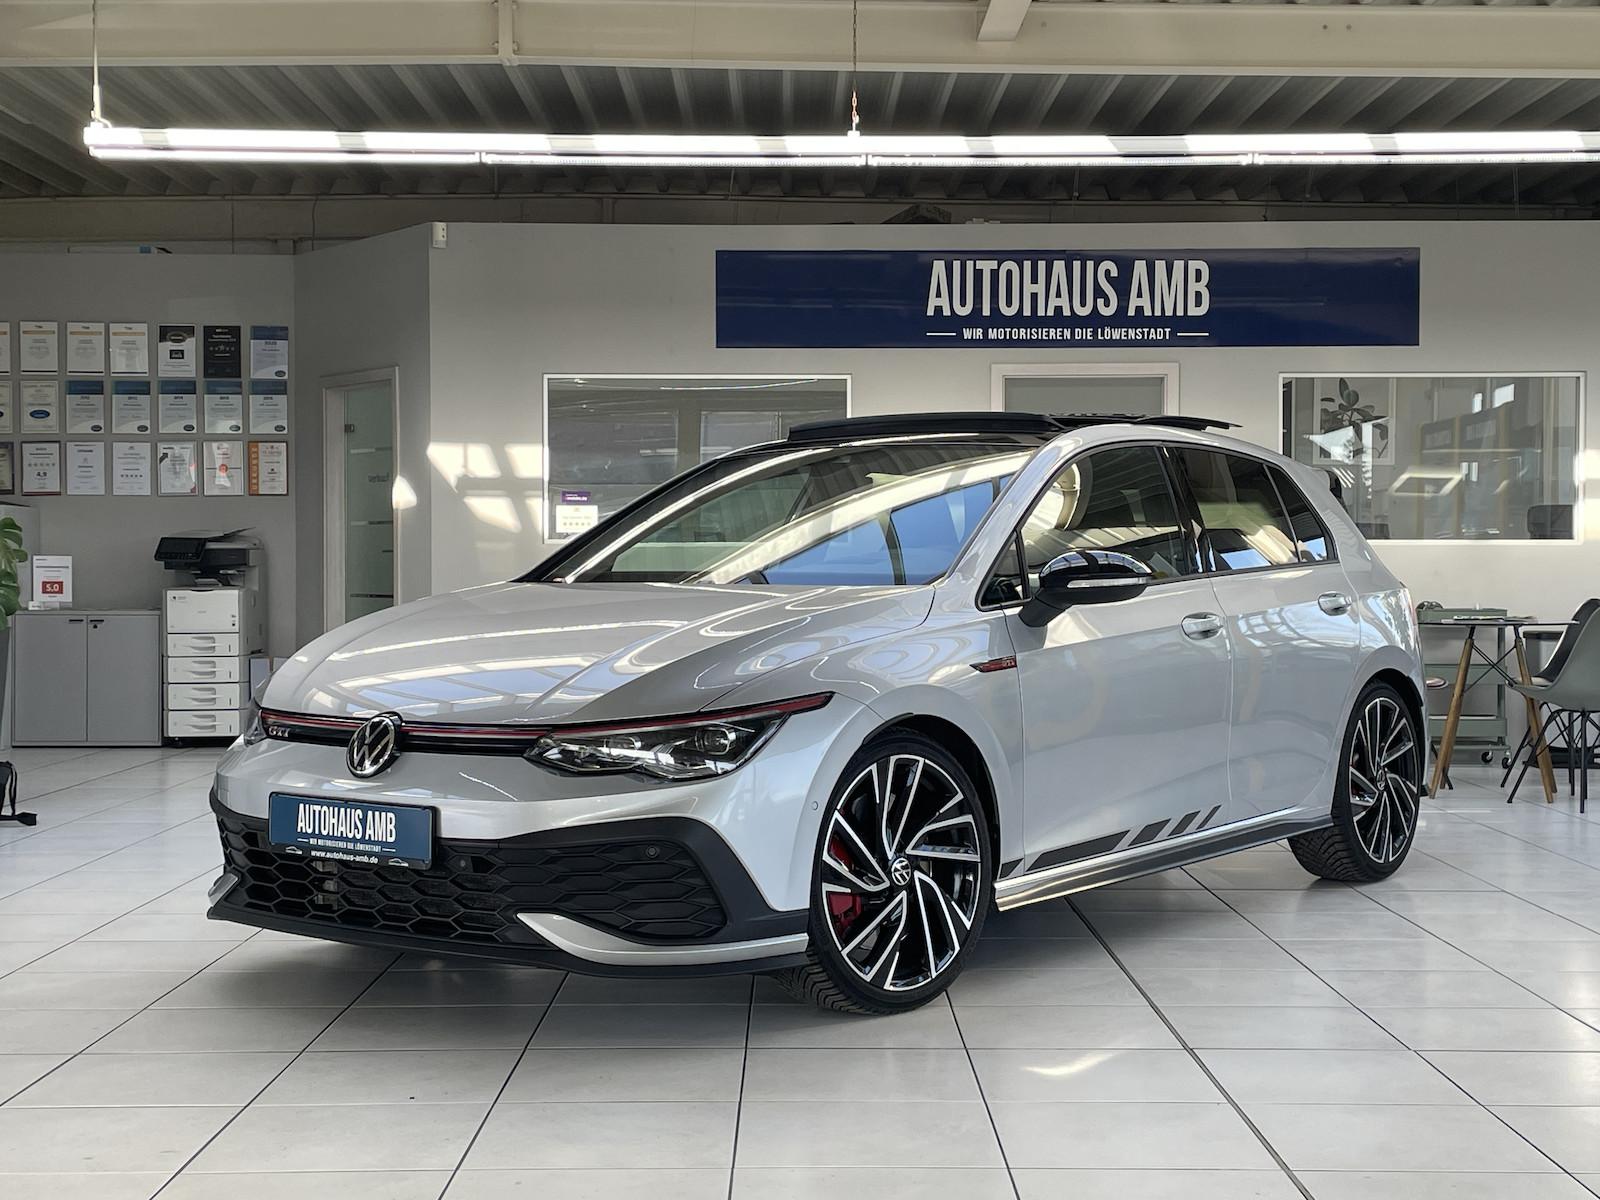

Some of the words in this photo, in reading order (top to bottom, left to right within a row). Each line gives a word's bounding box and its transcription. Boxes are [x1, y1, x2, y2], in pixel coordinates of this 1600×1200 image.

[926, 259, 1119, 317] AUTOHAUS
[1127, 259, 1210, 317] AMB
[962, 327, 984, 340] WIR
[988, 327, 1071, 340] MOTORISIEREN
[1074, 327, 1094, 340] DIE
[1097, 326, 1171, 340] LÖWENSTADT
[268, 726, 290, 738] GTI
[297, 803, 363, 840] AUTOHAUS
[365, 810, 396, 842] AMB
[310, 850, 378, 864] www.autohaus-amb.de
